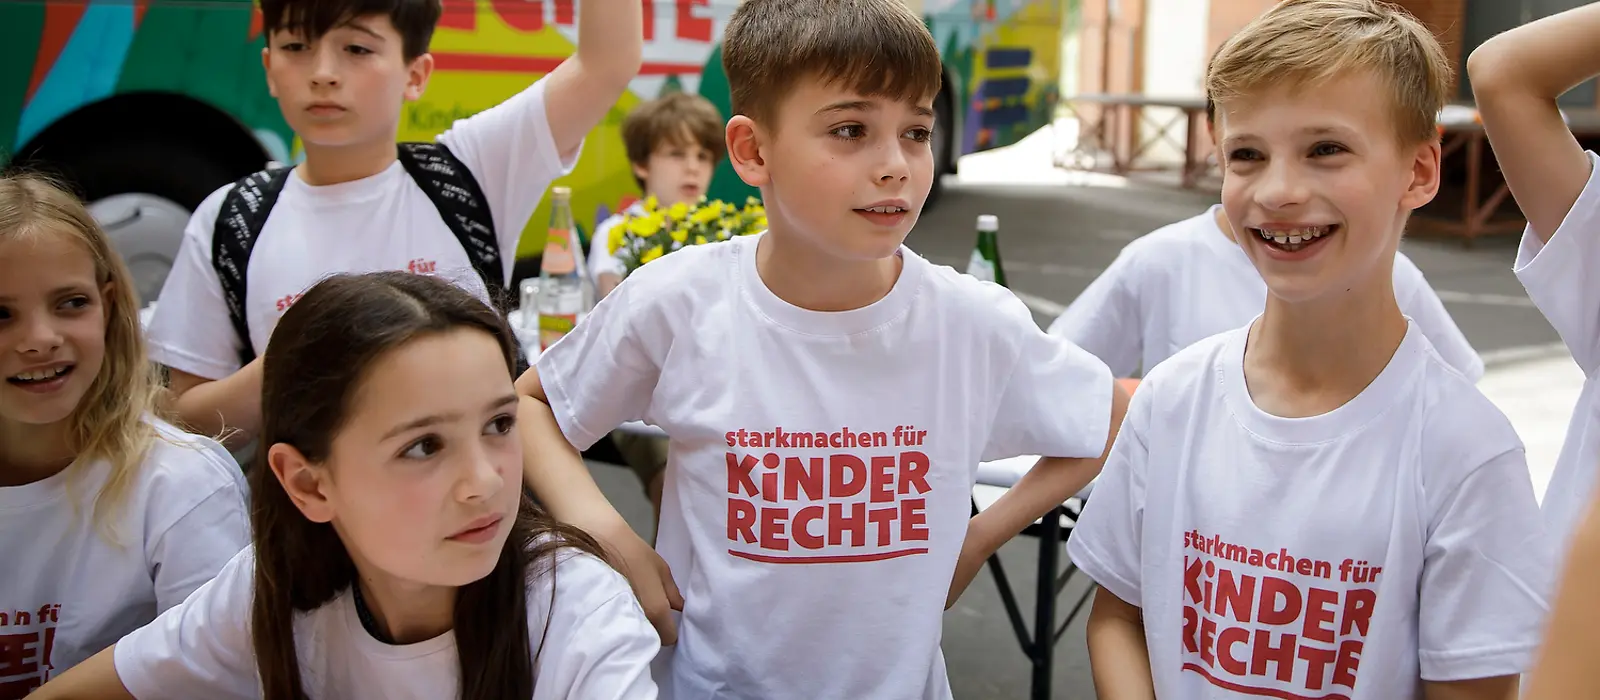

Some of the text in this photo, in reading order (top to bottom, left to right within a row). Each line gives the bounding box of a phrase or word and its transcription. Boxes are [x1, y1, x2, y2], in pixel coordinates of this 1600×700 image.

[725, 425, 927, 448] starkmachen für
[727, 498, 929, 551] RECHTE
[1184, 529, 1382, 583] starkmachen für
[1182, 605, 1364, 690] RECHTE
